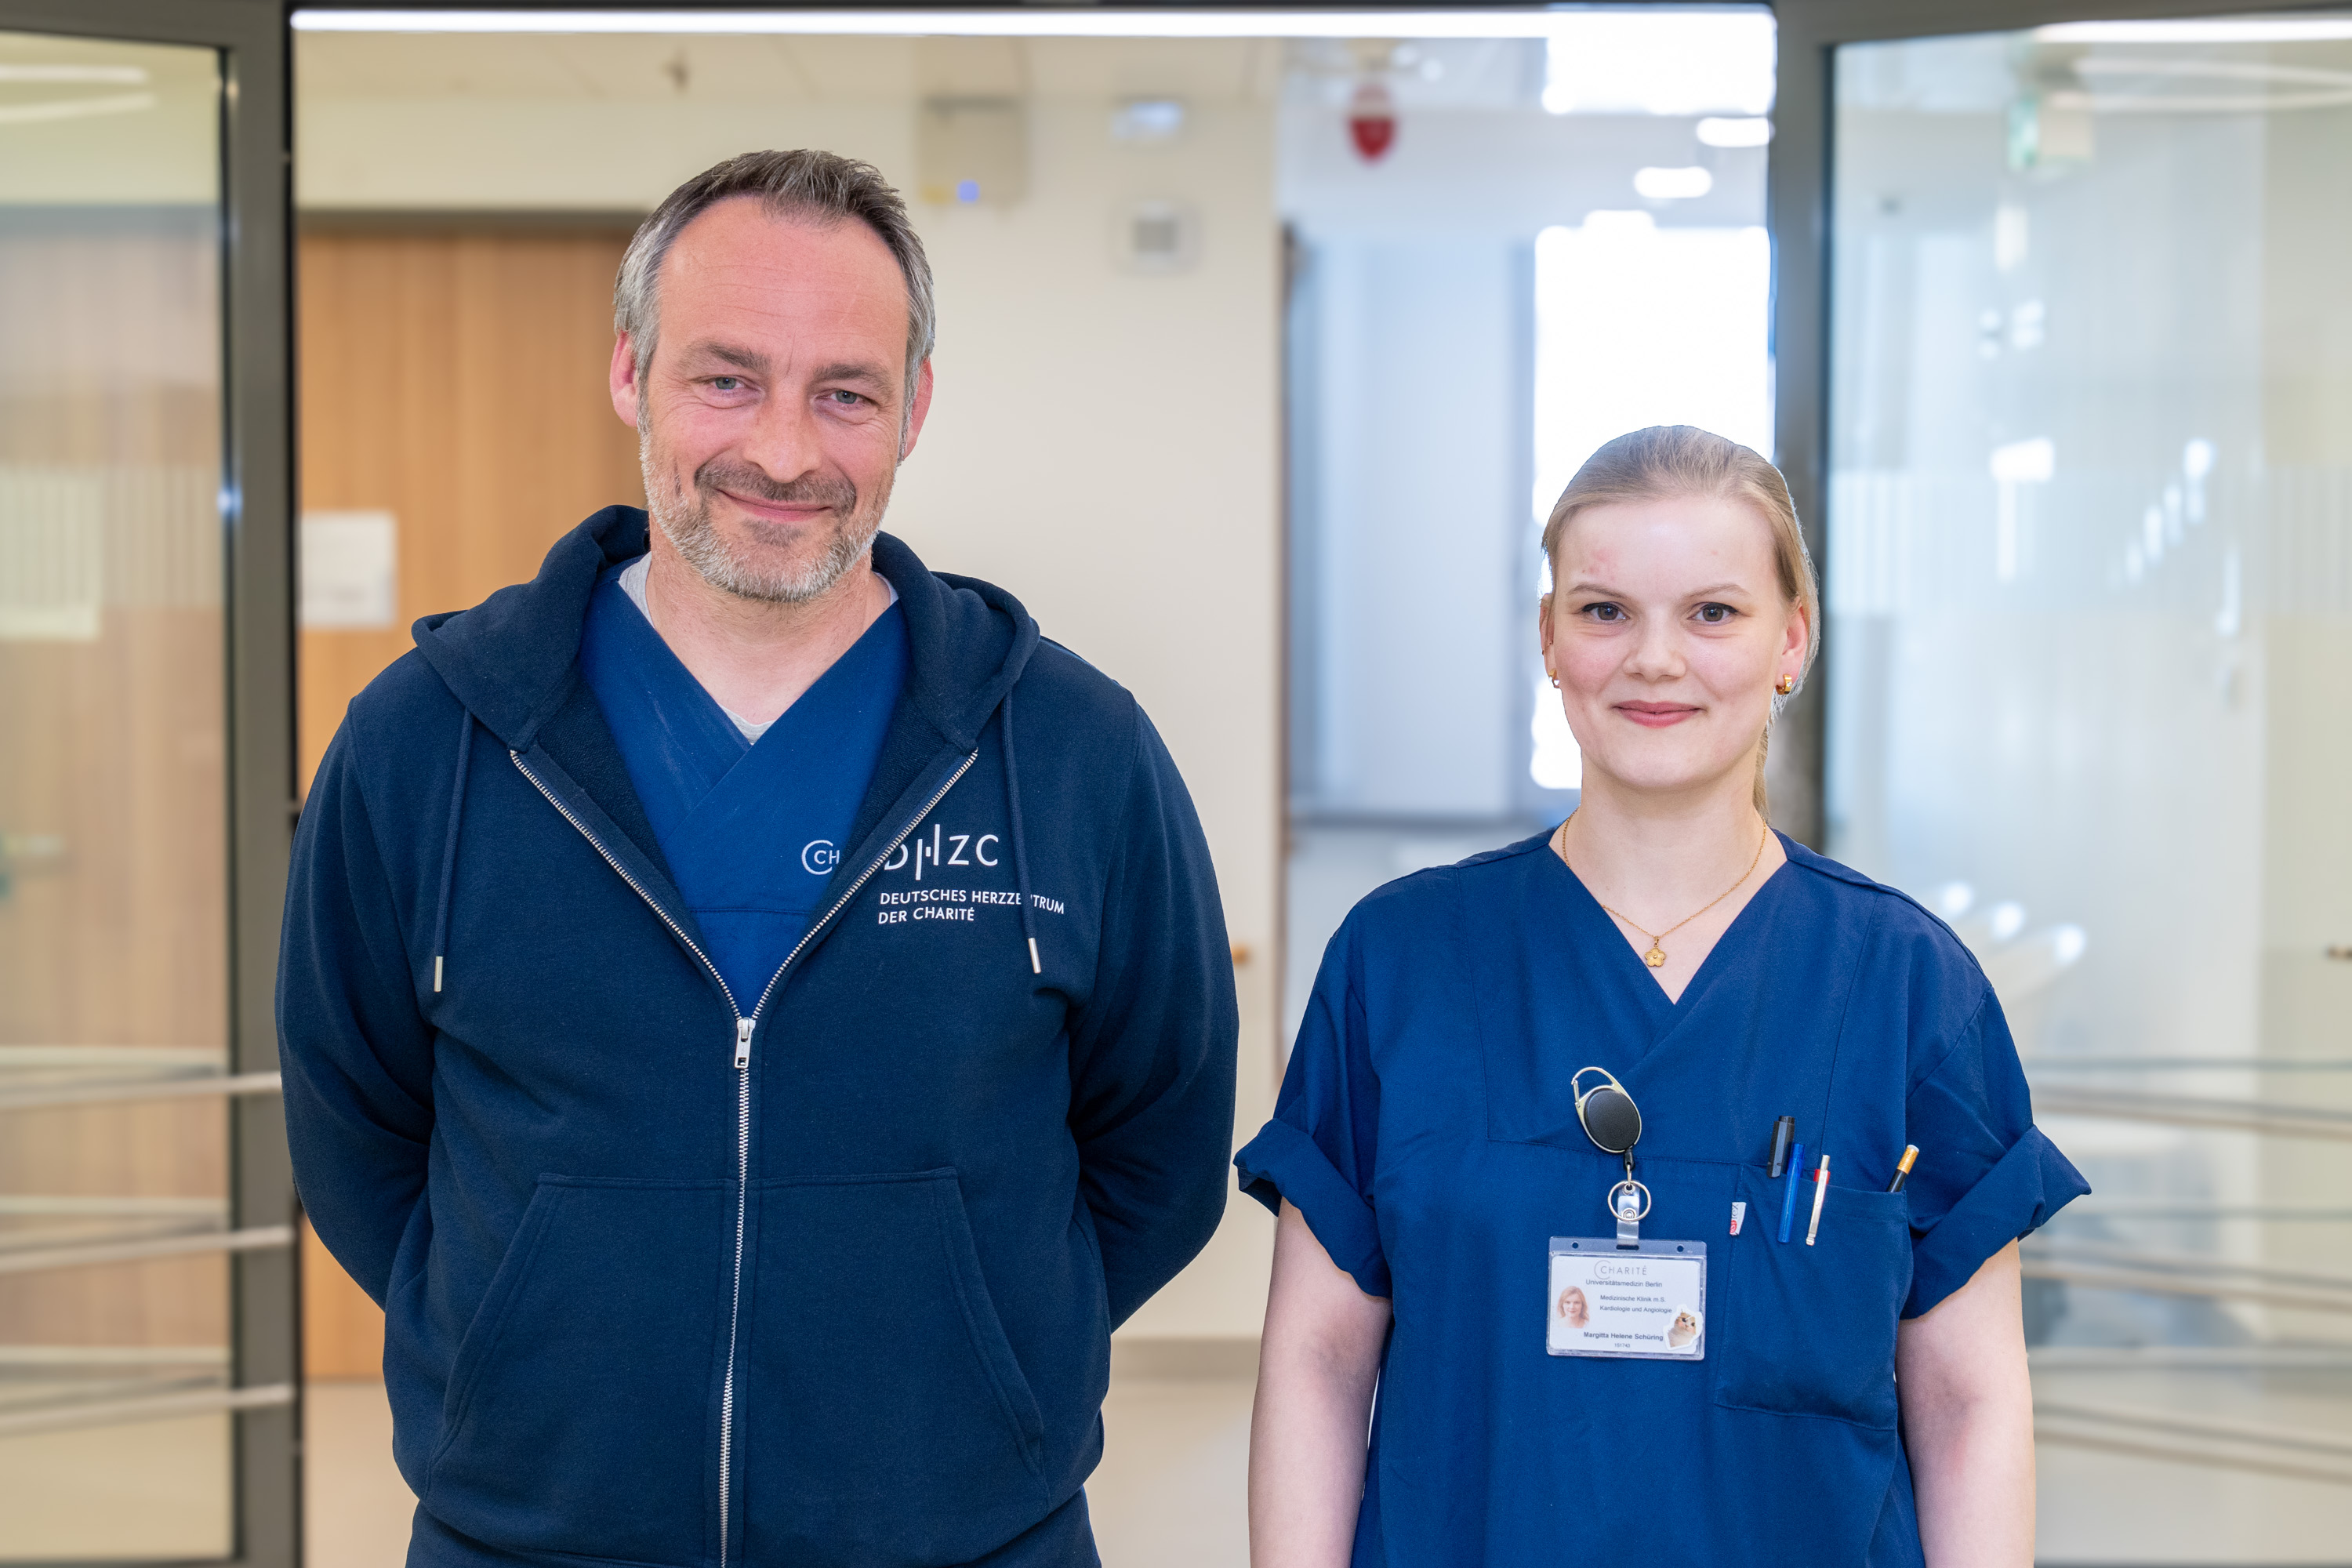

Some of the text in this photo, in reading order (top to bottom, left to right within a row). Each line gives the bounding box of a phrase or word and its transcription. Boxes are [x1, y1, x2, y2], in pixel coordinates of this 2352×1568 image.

[880, 889, 1065, 914] DEUTSCHES HERZZETRUM
[878, 906, 975, 924] DER CHARITÉ
